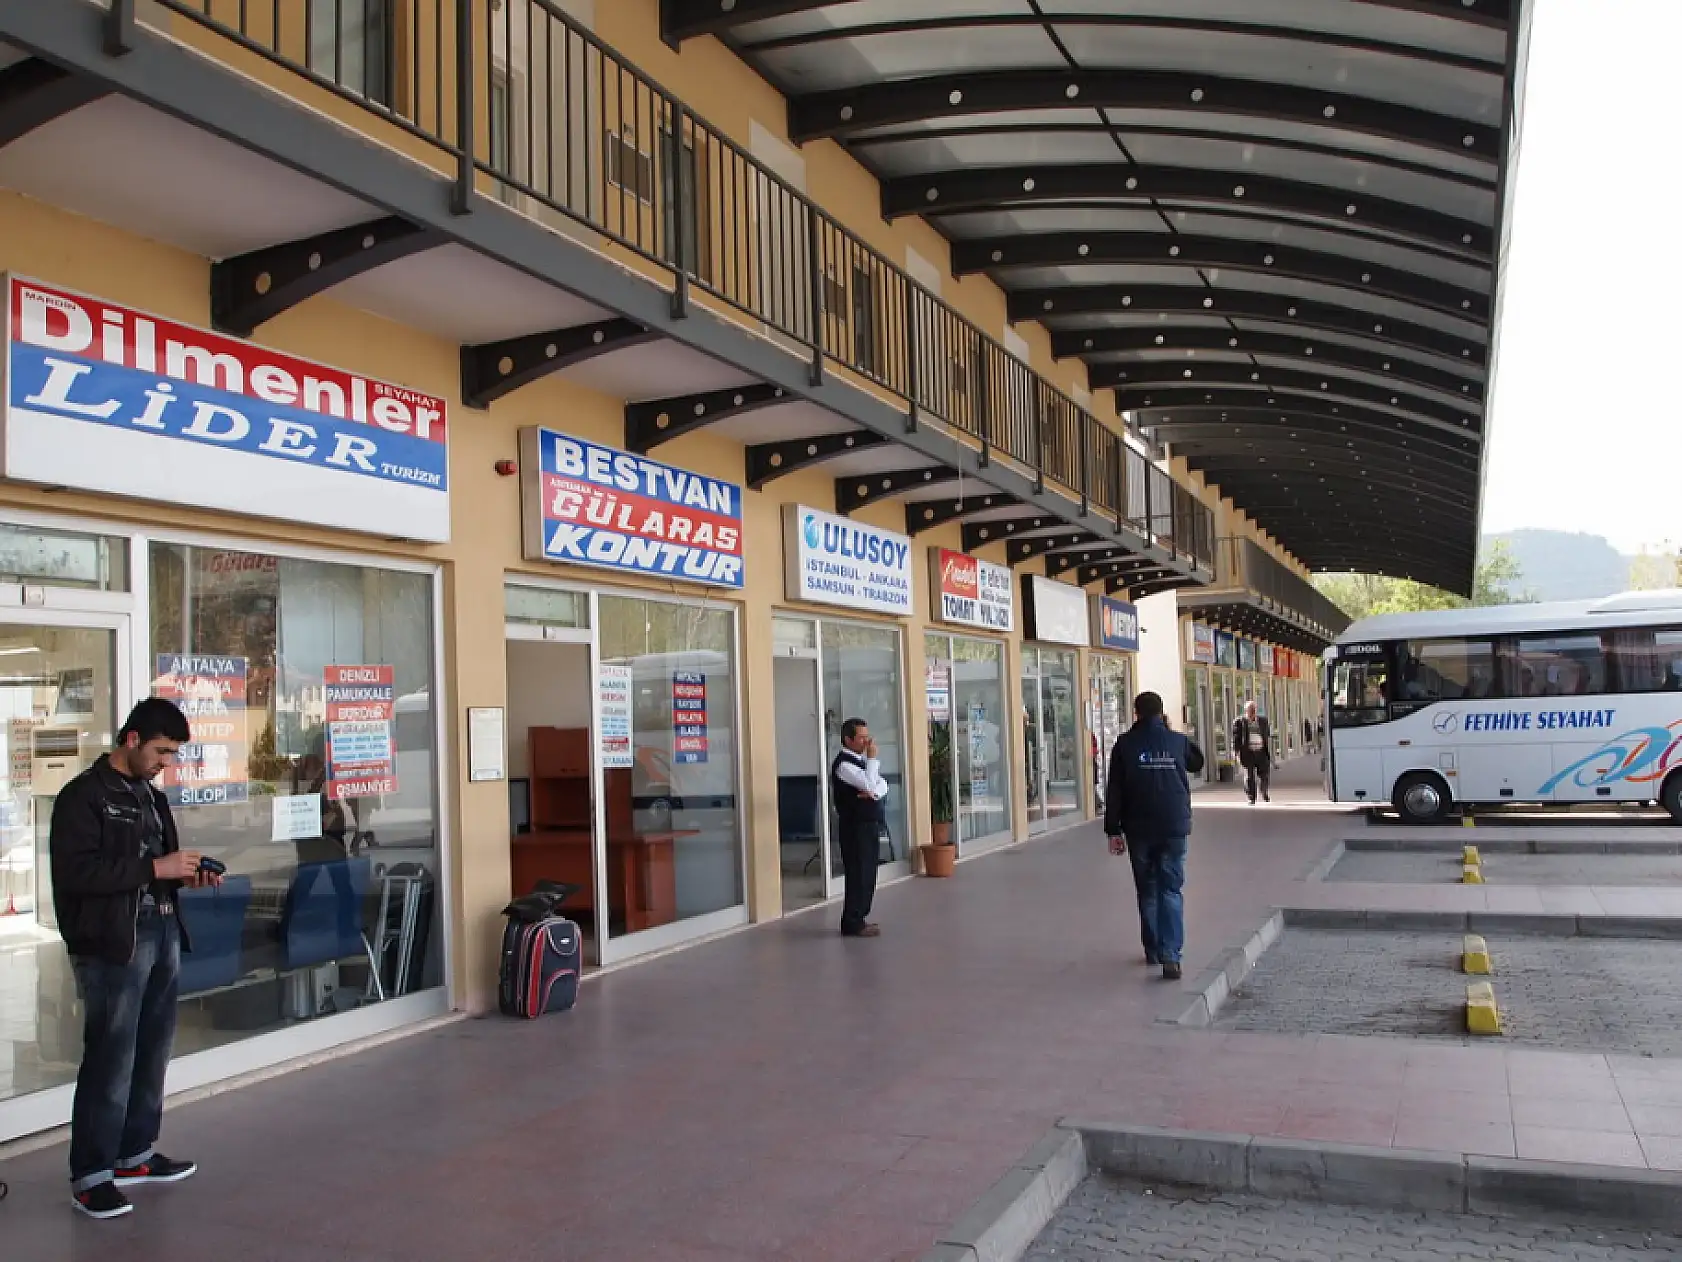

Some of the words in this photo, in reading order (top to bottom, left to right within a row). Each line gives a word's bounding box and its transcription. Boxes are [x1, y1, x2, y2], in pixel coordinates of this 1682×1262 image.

[21, 286, 440, 439] Dilmenler
[25, 356, 377, 472] LİDER
[374, 384, 437, 408] SEYAHAT
[554, 437, 732, 516] BESTVAN
[551, 488, 739, 551] GÜLARAS
[546, 523, 742, 582] KONTUR
[823, 521, 908, 570] ULUSOY
[807, 576, 855, 596] SAMSUN
[863, 587, 908, 605] TRABZON
[868, 572, 908, 590] ANKARA
[171, 658, 235, 676] ANTALYA
[327, 687, 393, 702] PAMUKKALE
[1464, 710, 1532, 731] FETHİYE
[1536, 710, 1616, 729] SEYAHAT
